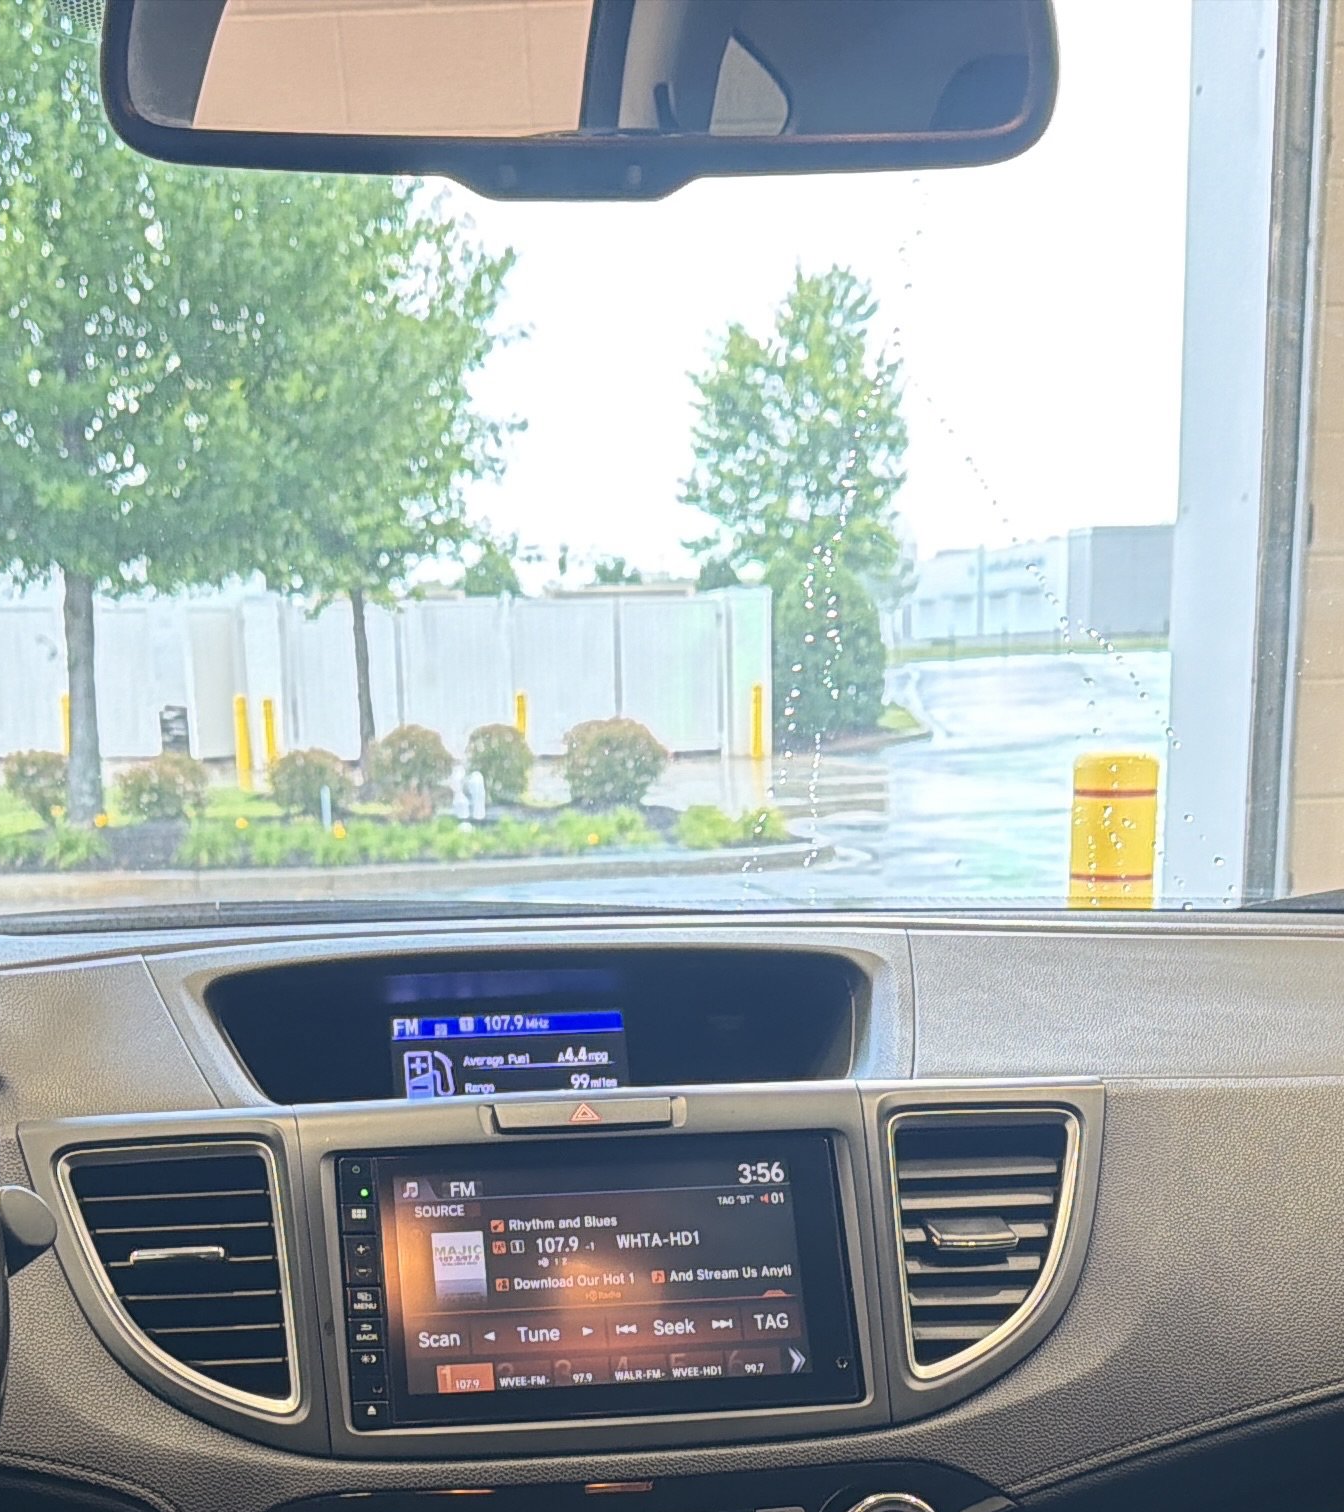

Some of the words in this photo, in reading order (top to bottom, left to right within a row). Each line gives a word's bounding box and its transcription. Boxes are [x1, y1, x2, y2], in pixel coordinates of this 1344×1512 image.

[393, 1018, 419, 1036] FM
[484, 1015, 523, 1031] 107.9
[463, 1054, 504, 1067] Average
[570, 1073, 589, 1088] 99
[738, 1162, 785, 1184] 3:56
[450, 1181, 476, 1198] FM
[415, 1204, 465, 1218] SOURCE
[509, 1218, 555, 1232] Rhythm
[559, 1215, 580, 1228] and
[585, 1215, 618, 1228] Blues
[536, 1236, 579, 1253] 107.9
[616, 1231, 700, 1249] WHTA-HD1
[434, 1244, 483, 1257] MAJIC
[514, 1274, 574, 1290] Download
[577, 1273, 599, 1286] Our
[603, 1272, 625, 1286] Hot
[670, 1268, 693, 1282] And
[697, 1266, 739, 1281] Stream
[742, 1266, 757, 1278] Us
[354, 1302, 377, 1311] MENU
[418, 1331, 460, 1348] Scan
[517, 1326, 560, 1342] Tune
[653, 1318, 696, 1336] Seek
[753, 1312, 789, 1331] TAG
[744, 1362, 765, 1374] 99.7
[455, 1379, 480, 1391] 107.9
[572, 1372, 593, 1384] 97.9
